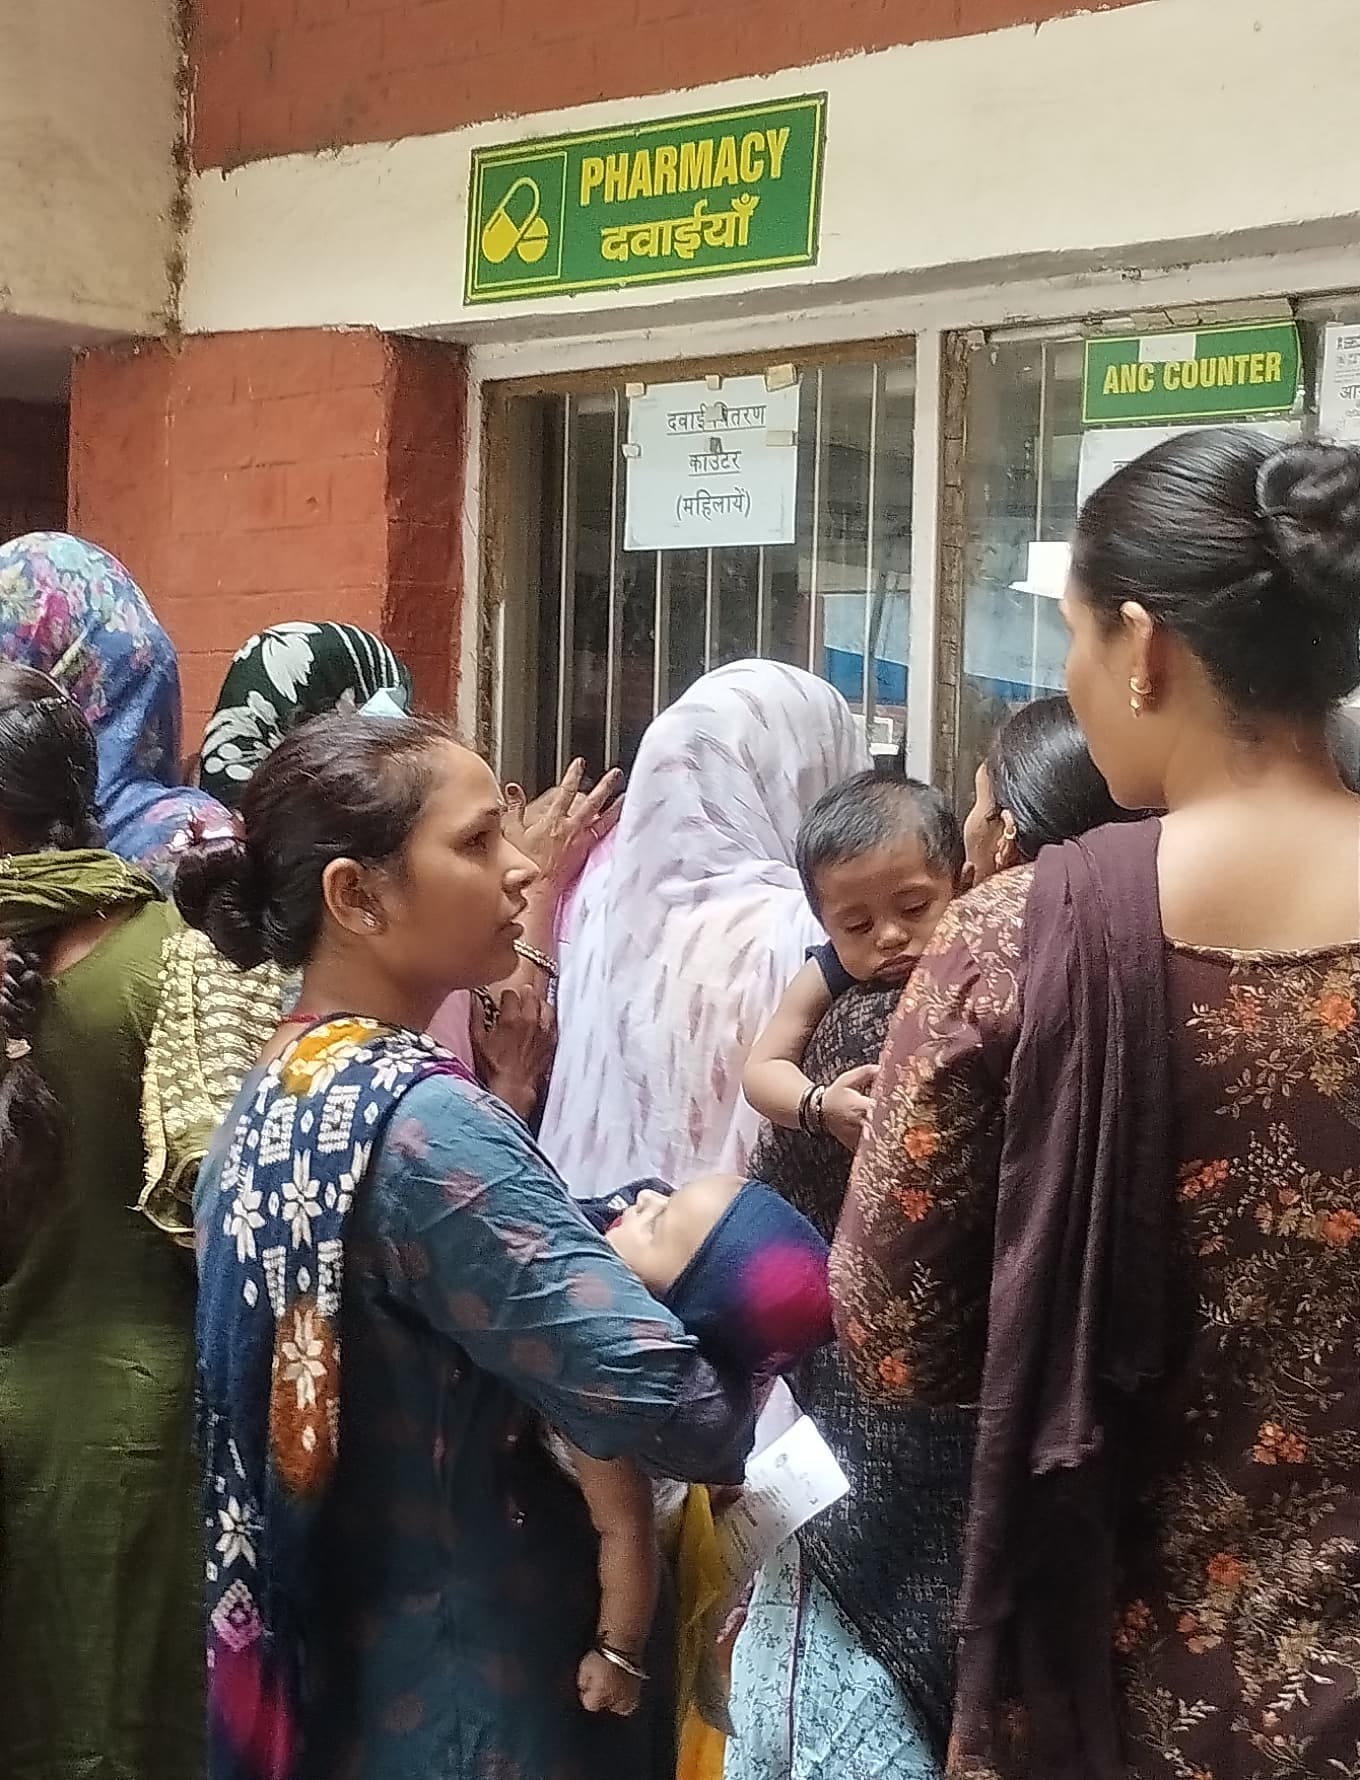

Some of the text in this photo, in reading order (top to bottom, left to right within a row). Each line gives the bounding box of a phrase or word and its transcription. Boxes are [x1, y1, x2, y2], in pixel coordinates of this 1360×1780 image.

[580, 127, 790, 207] PHARMACY
[600, 193, 760, 262] दवाईयाँ
[1103, 352, 1282, 394] ANC COUNTER
[667, 403, 705, 431] दवाई
[689, 449, 741, 473] काउटर
[676, 487, 751, 520] (महिलायें)
